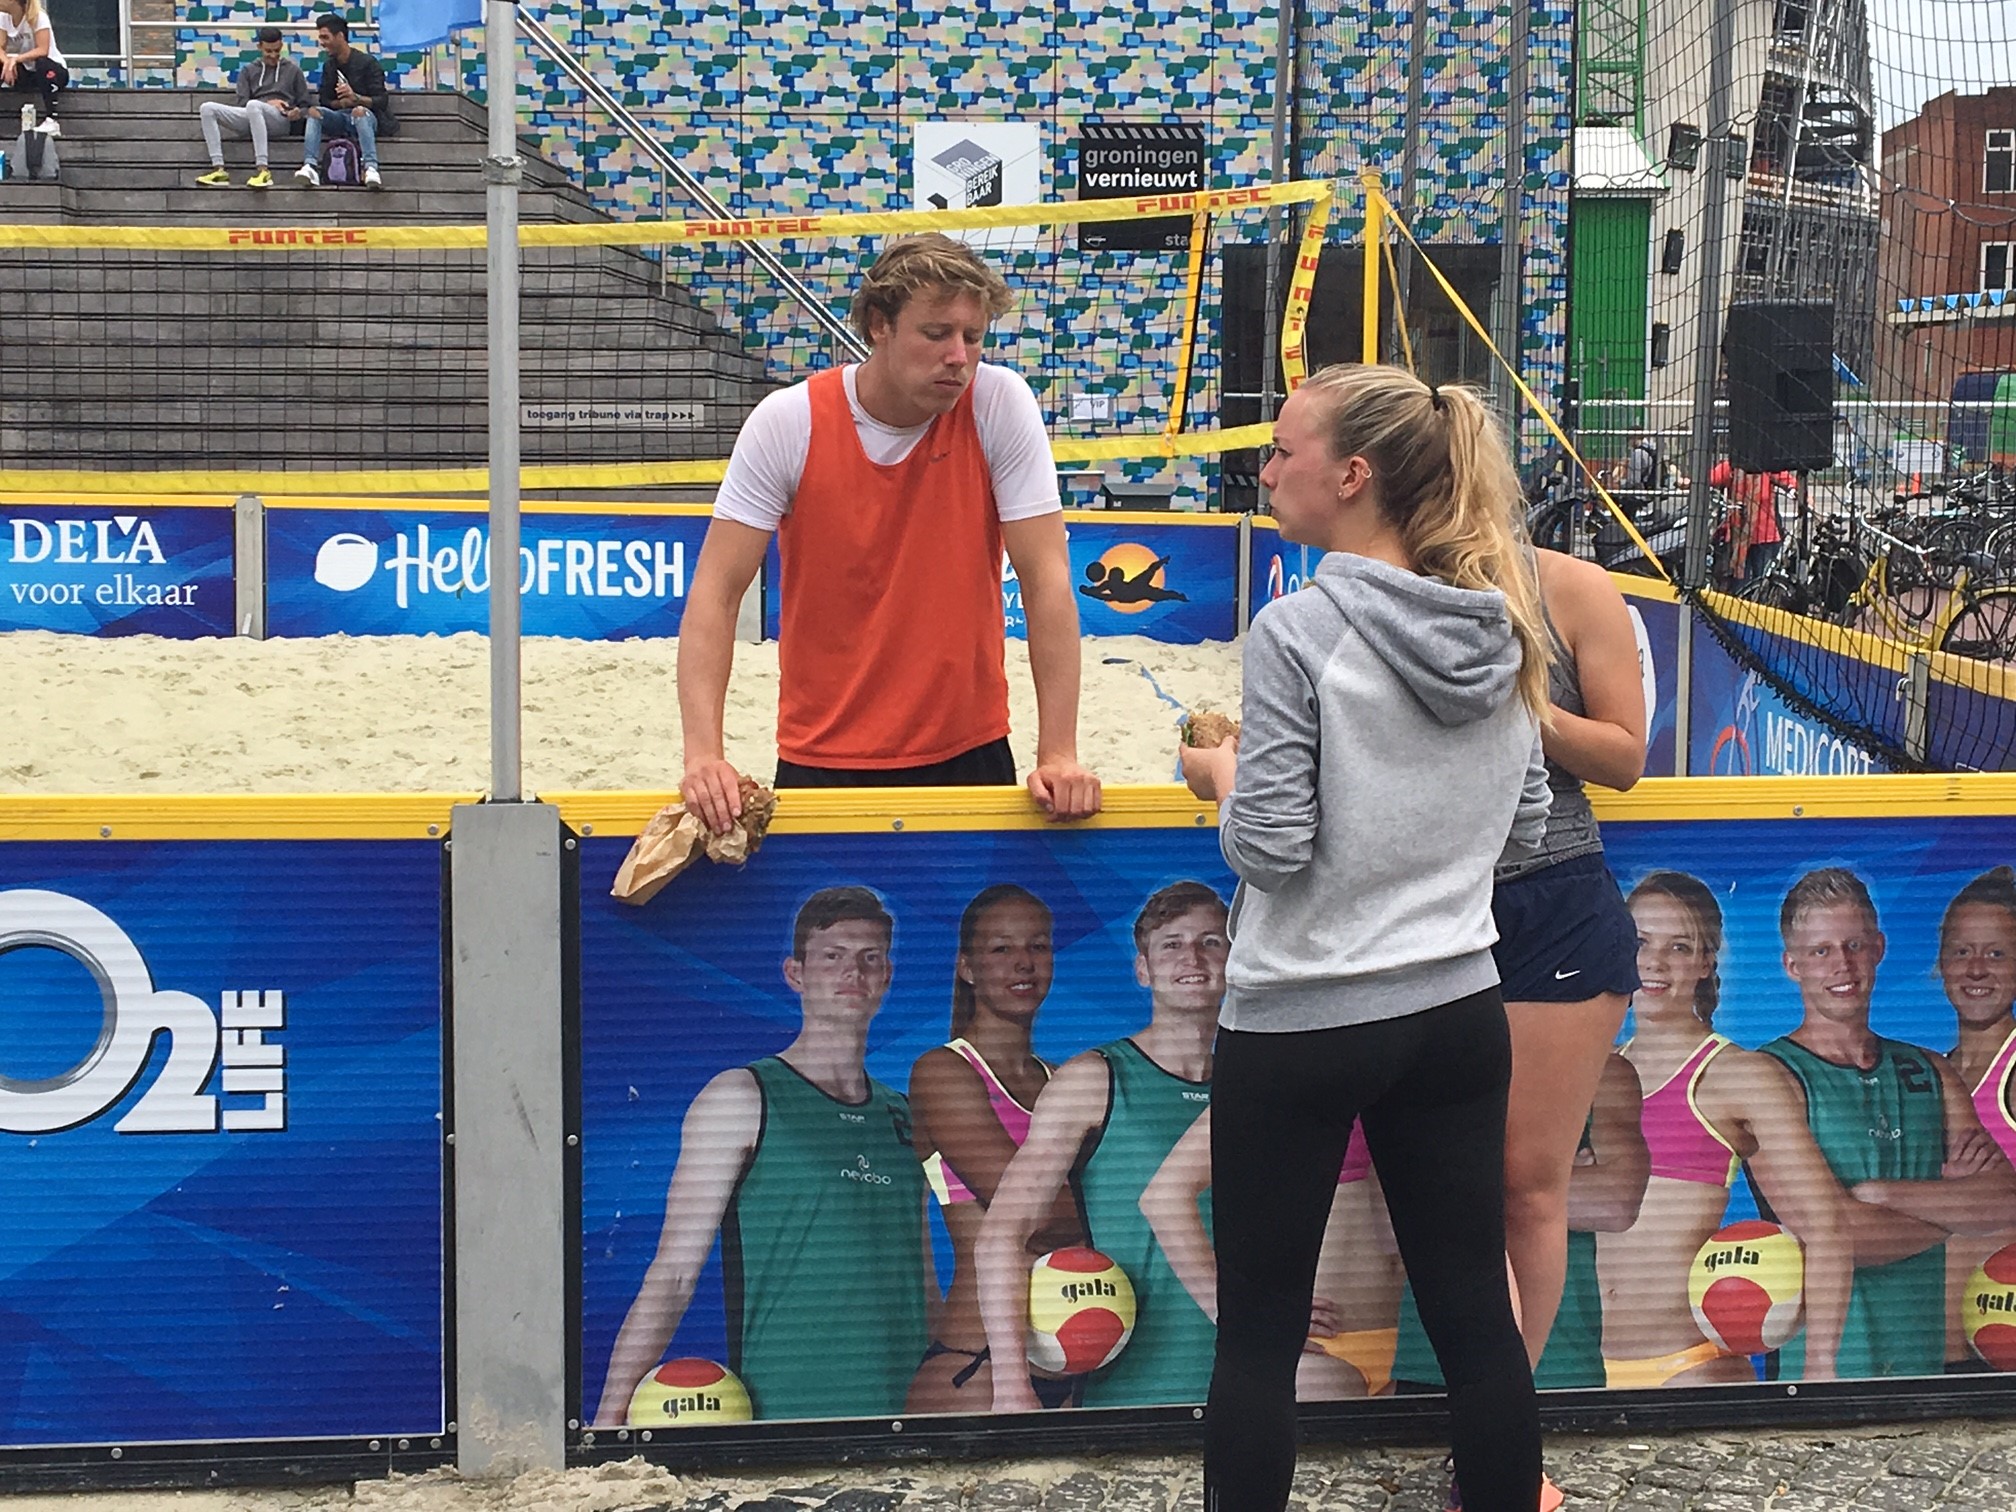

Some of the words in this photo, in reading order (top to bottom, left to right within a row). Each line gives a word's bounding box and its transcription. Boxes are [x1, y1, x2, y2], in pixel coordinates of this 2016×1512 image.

[1085, 144, 1198, 168] groningen
[967, 164, 999, 192] BEREIK
[1085, 167, 1198, 188] vernieuwt
[966, 182, 993, 206] BAAR
[228, 229, 368, 245] FUNTEC
[685, 217, 822, 237] FUNTEC
[1165, 233, 1189, 246] sta
[527, 409, 576, 421] toegang
[578, 409, 621, 420] tribune
[624, 409, 642, 420] via
[645, 410, 670, 421] trap
[8, 516, 167, 564] DELA
[384, 524, 684, 608] HeloFRESH
[10, 582, 85, 605] voor
[95, 574, 199, 606] elkaar
[221, 989, 284, 1129] LIFE
[1704, 1246, 1760, 1273] gala
[1061, 1278, 1117, 1304] gala
[1976, 1291, 2016, 1316] gal
[662, 1392, 721, 1419] gala
